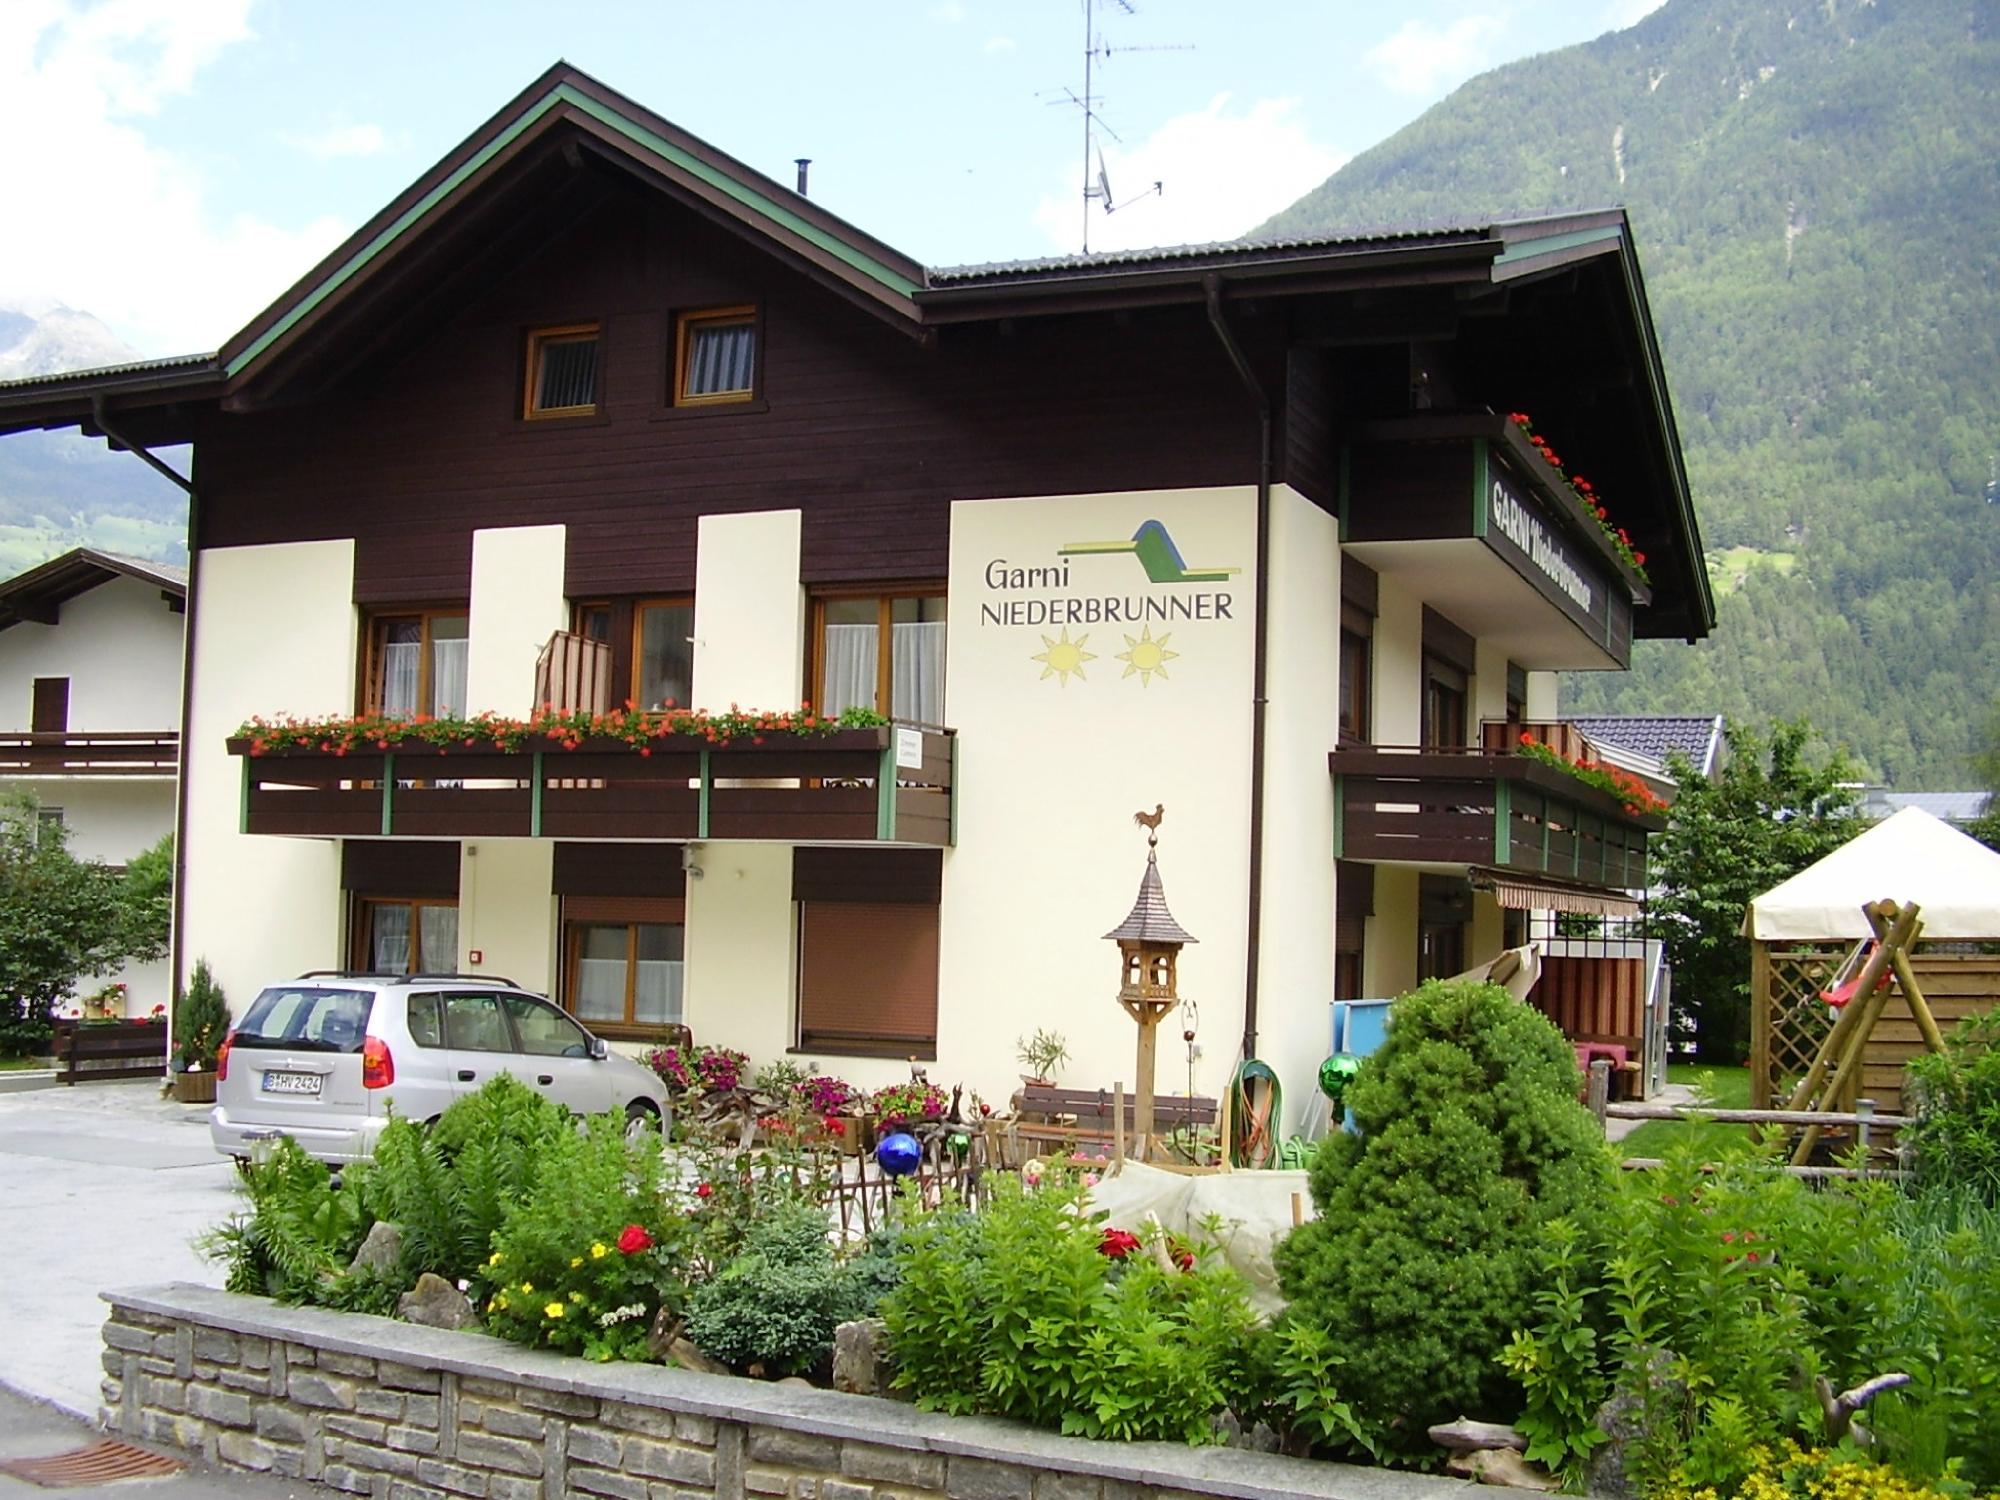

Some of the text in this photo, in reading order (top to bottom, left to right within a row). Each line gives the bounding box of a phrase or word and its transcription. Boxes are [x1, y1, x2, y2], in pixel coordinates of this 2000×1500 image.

[1493, 481, 1530, 554] GARNI
[985, 558, 1069, 589] Garni
[981, 593, 1233, 626] NIEDERBRUNNER
[295, 1076, 318, 1090] 2424
